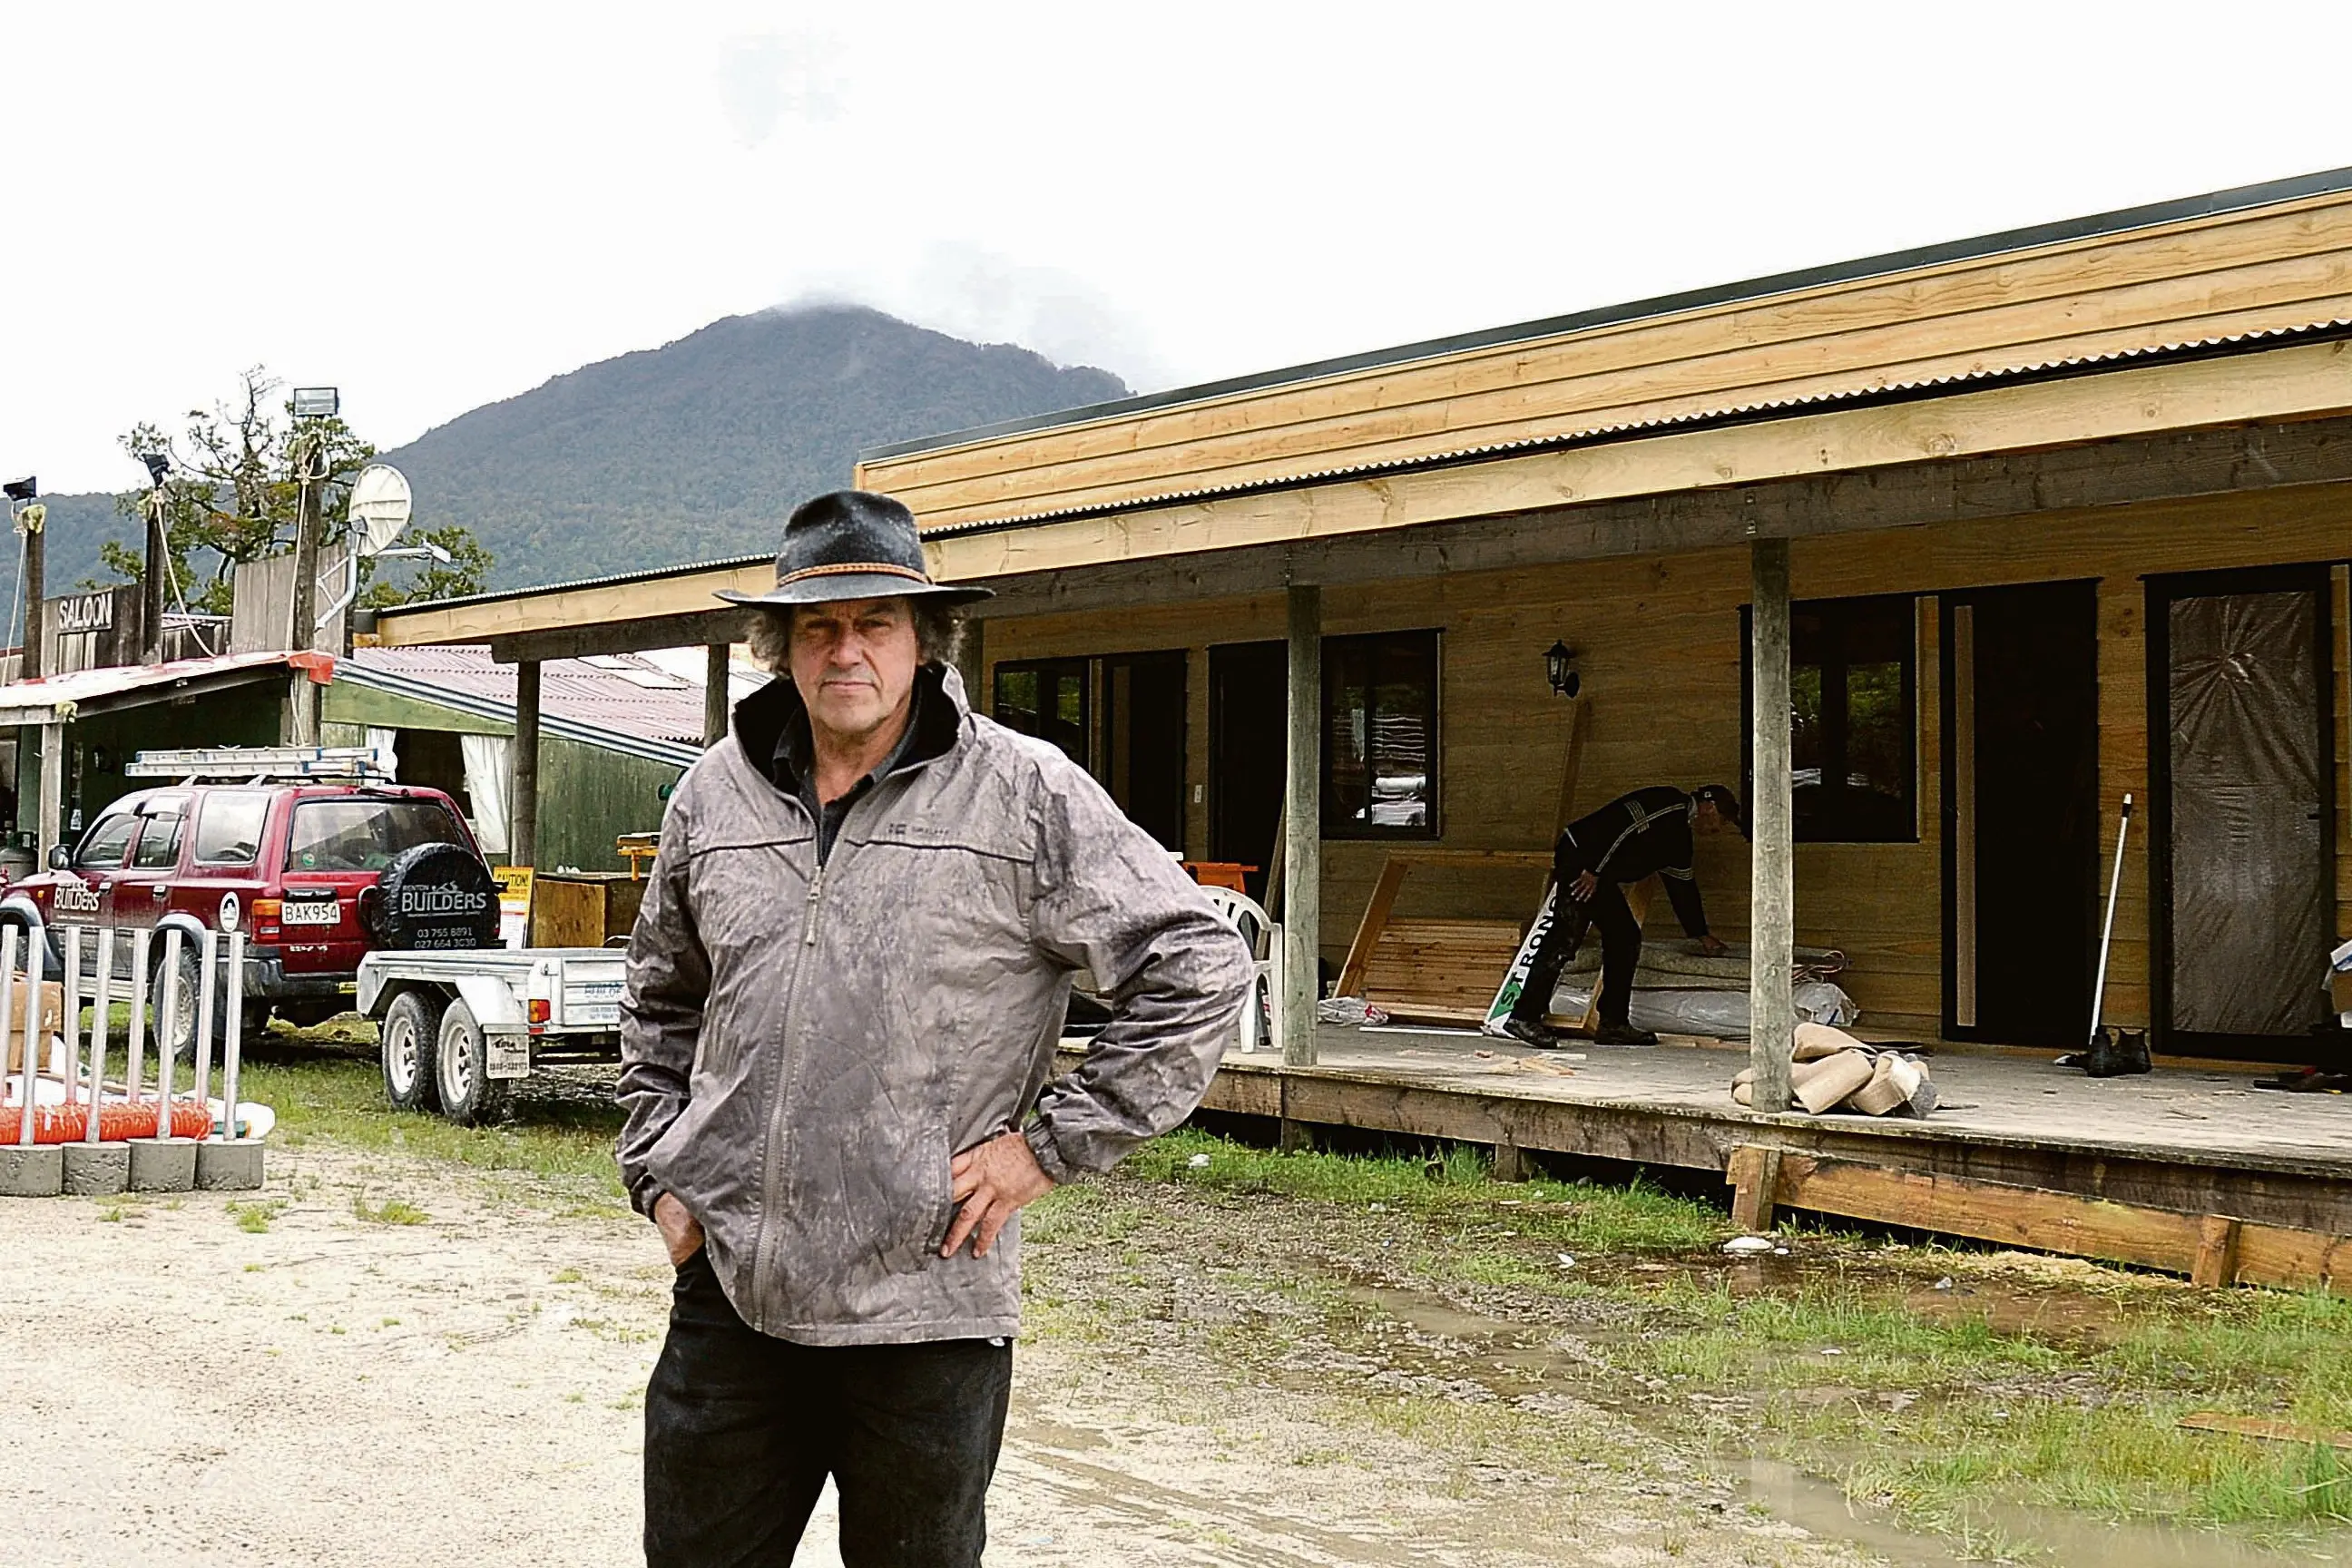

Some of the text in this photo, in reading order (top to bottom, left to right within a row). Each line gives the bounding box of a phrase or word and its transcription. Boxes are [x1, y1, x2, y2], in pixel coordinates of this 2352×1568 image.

[59, 593, 112, 629] SALOON
[54, 887, 100, 911] BUILDERS
[401, 891, 487, 913] BUILDERS
[285, 905, 338, 921] BAK954
[417, 928, 428, 938] 03
[431, 927, 448, 937] 755
[414, 939, 432, 949] 027
